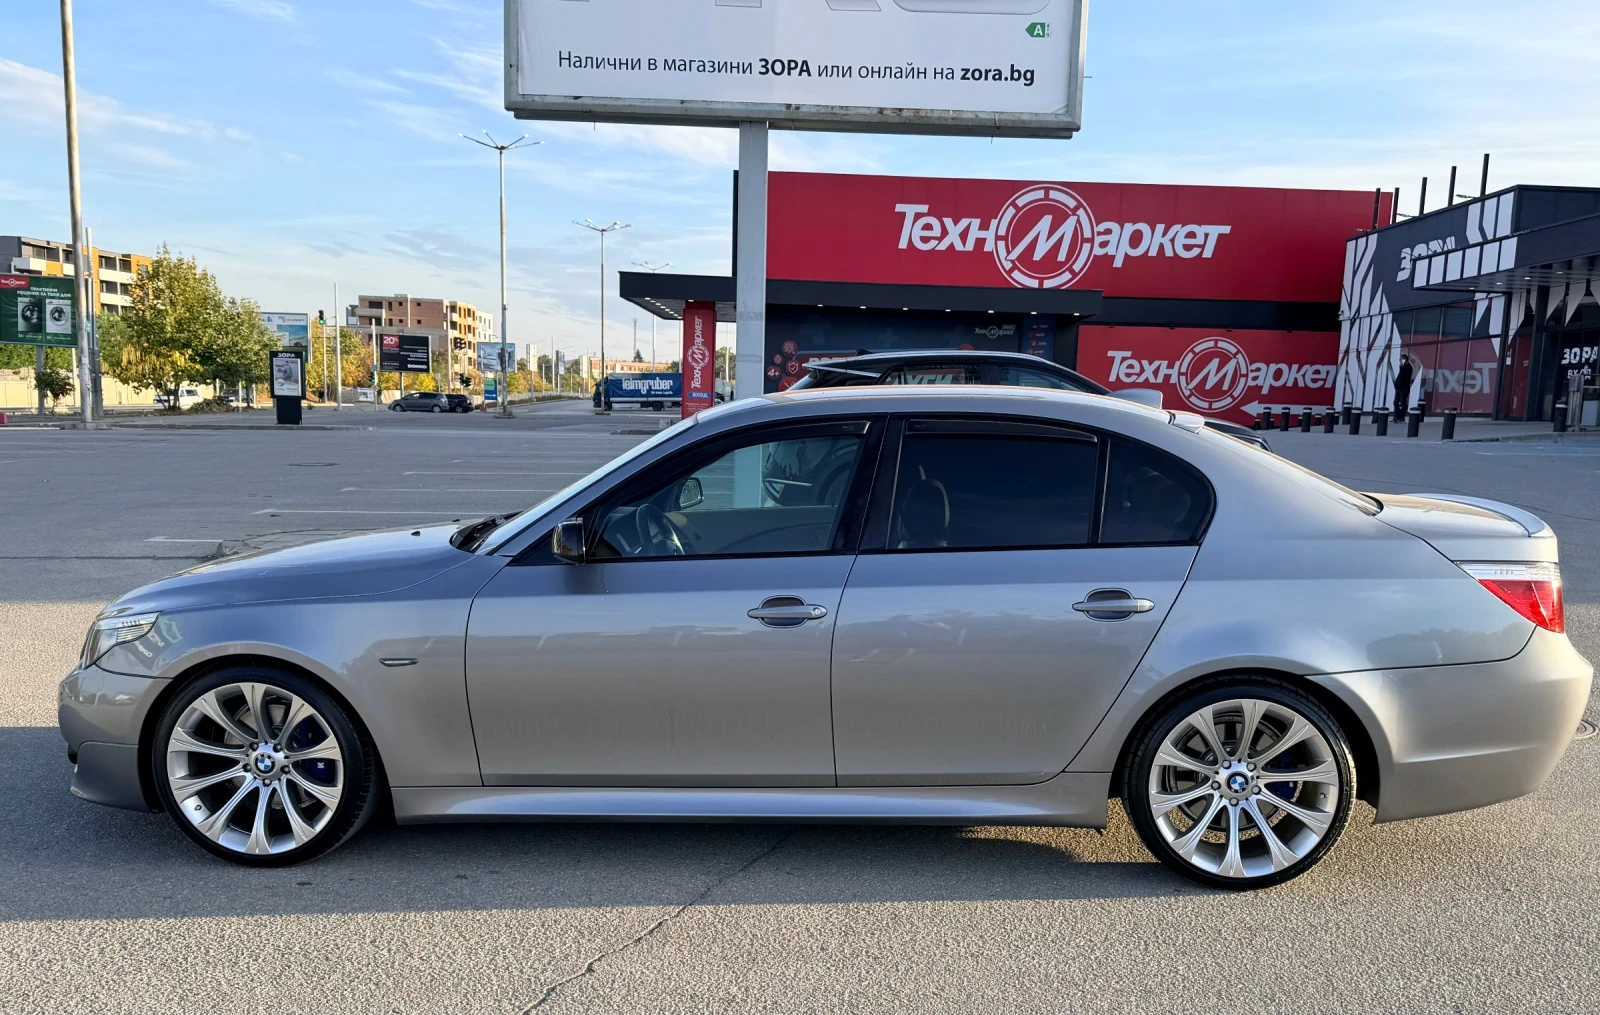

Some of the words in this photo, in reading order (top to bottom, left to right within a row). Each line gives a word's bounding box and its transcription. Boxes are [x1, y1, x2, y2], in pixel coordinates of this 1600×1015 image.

[1033, 24, 1044, 36] A
[558, 50, 642, 70] Налични
[647, 58, 658, 71] в
[663, 58, 753, 75] магазини
[758, 58, 812, 77] ЗОРА
[817, 64, 852, 78] или
[858, 62, 928, 80] онлайн
[933, 66, 955, 81] на
[960, 64, 1035, 87] zora.bg
[1561, 346, 1599, 365] ЗОРА
[767, 368, 780, 378] 4+
